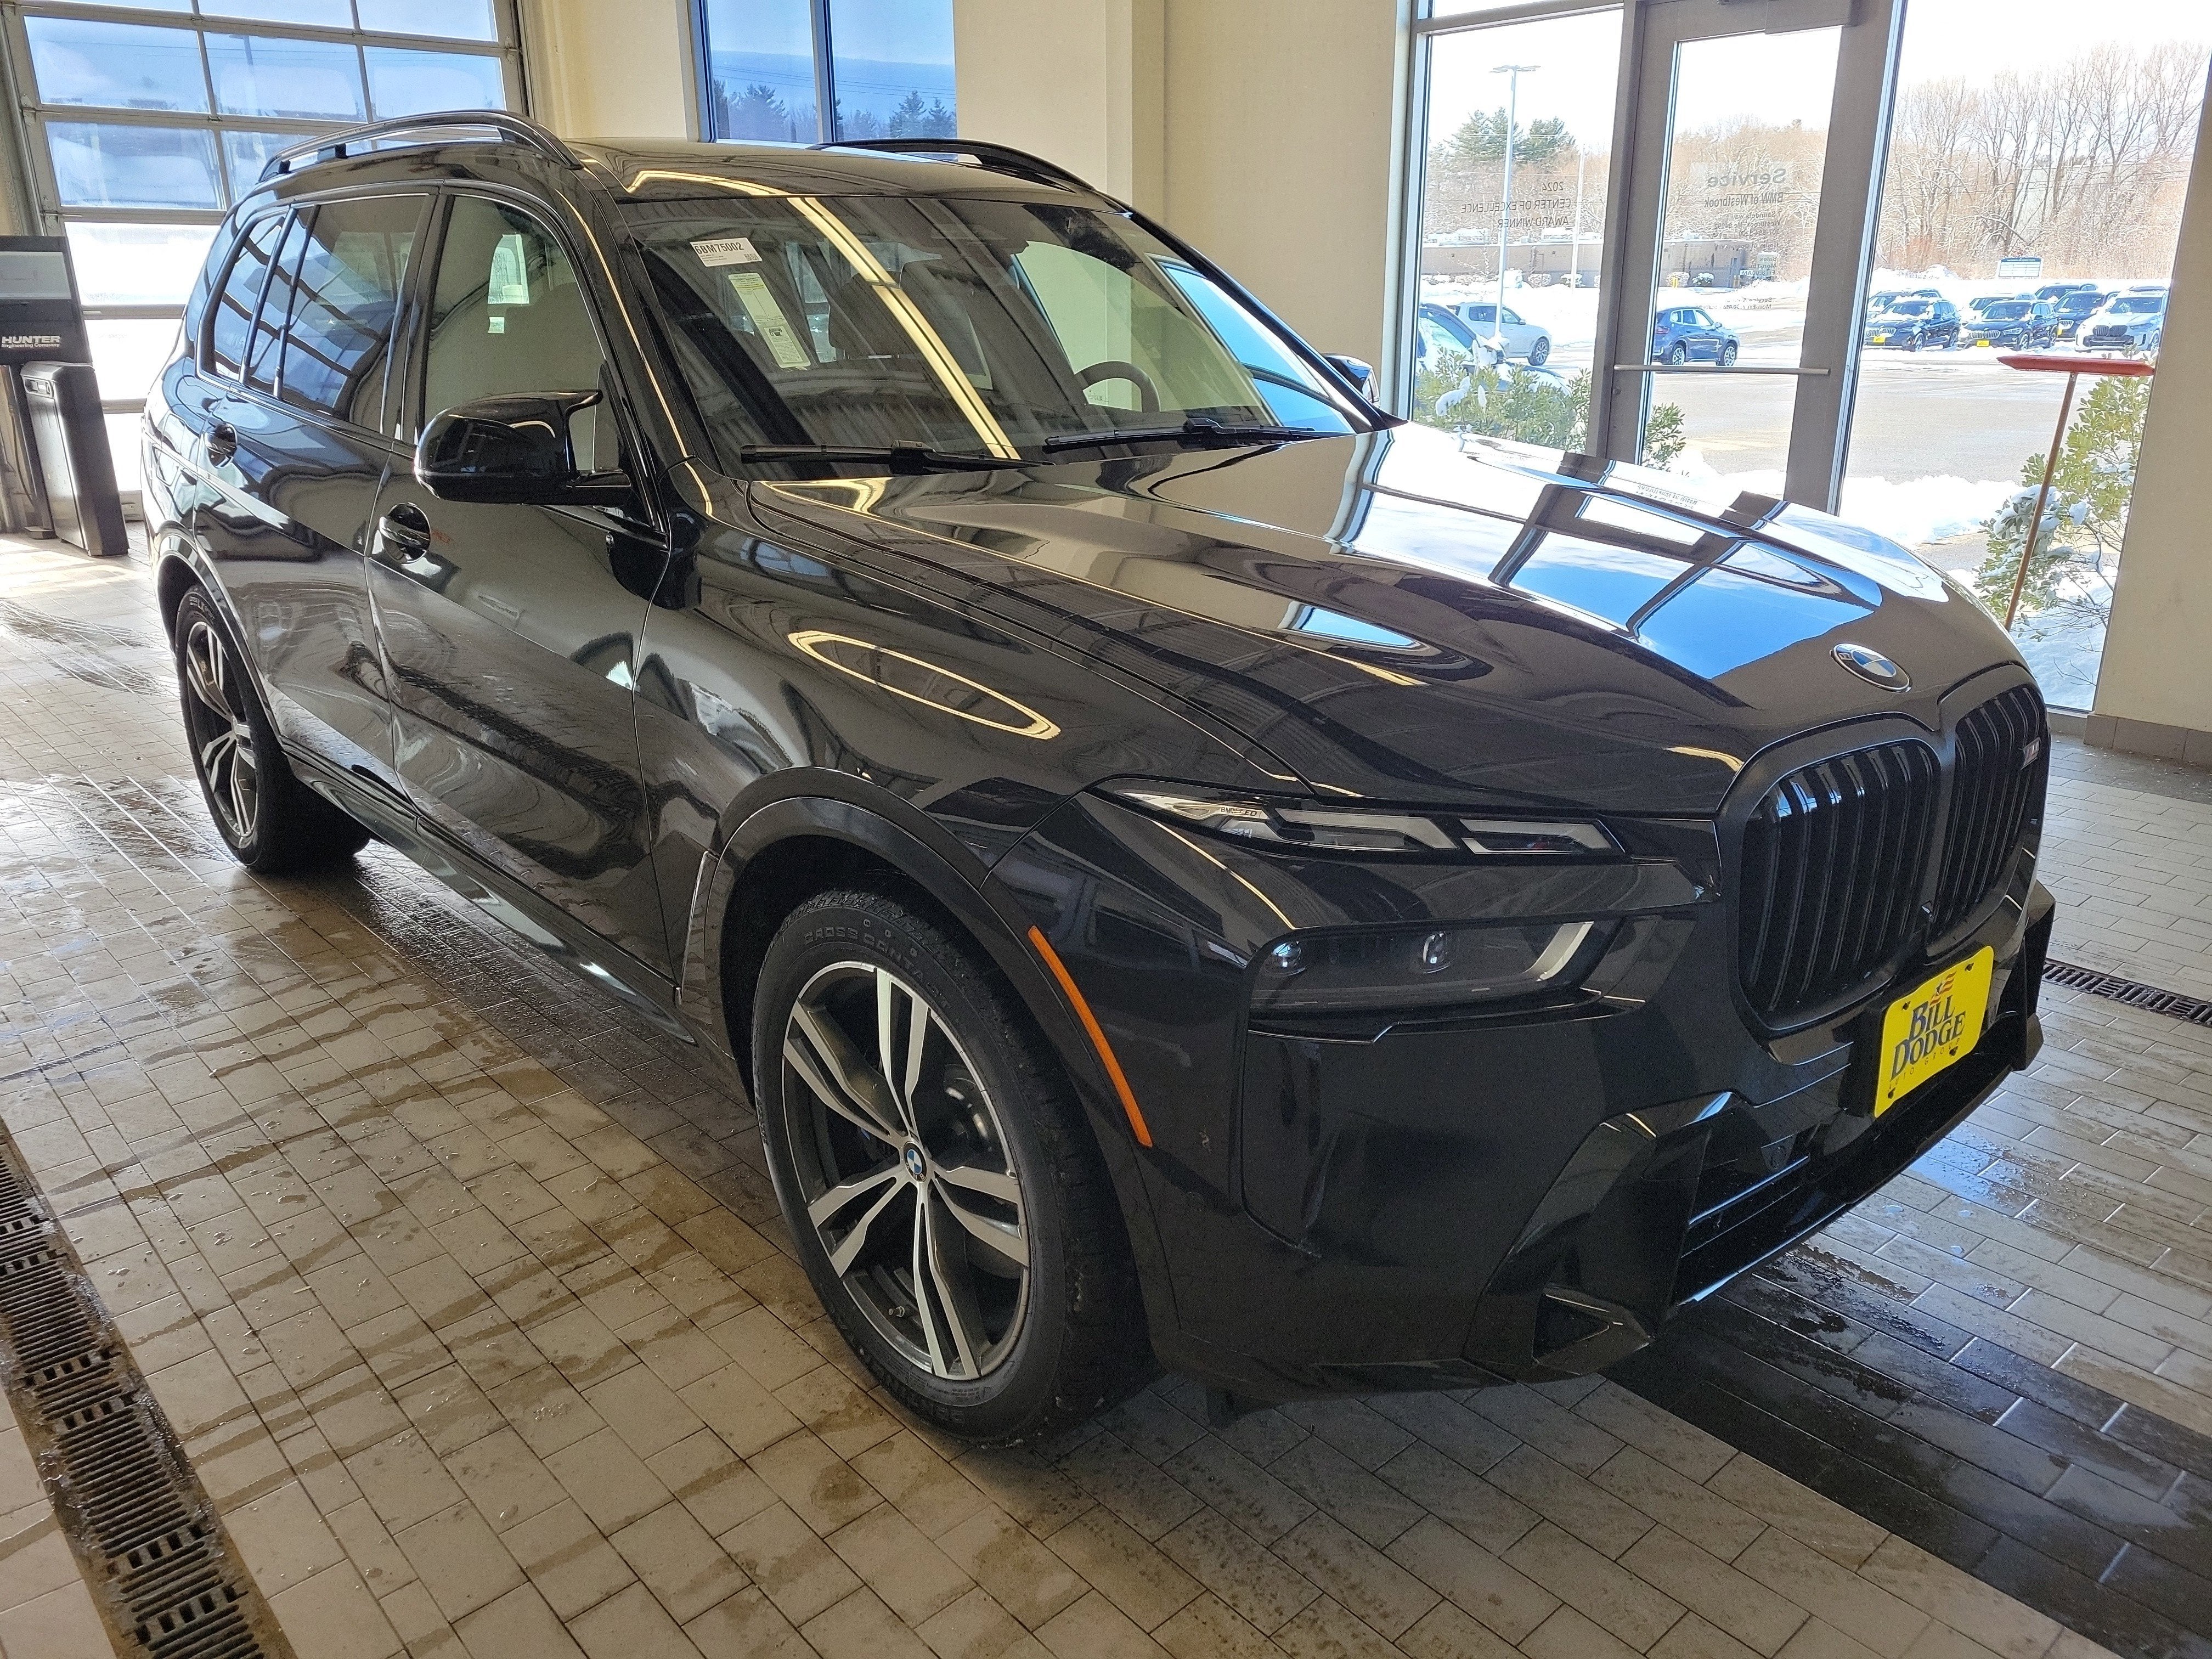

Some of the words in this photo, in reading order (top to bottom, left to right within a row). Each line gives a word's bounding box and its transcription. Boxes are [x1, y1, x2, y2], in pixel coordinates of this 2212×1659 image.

[694, 242, 744, 255] 6BM75002
[1909, 995, 1956, 1041] BILL
[1889, 1011, 1967, 1082] DODGE
[1925, 1037, 1960, 1065] GROUP
